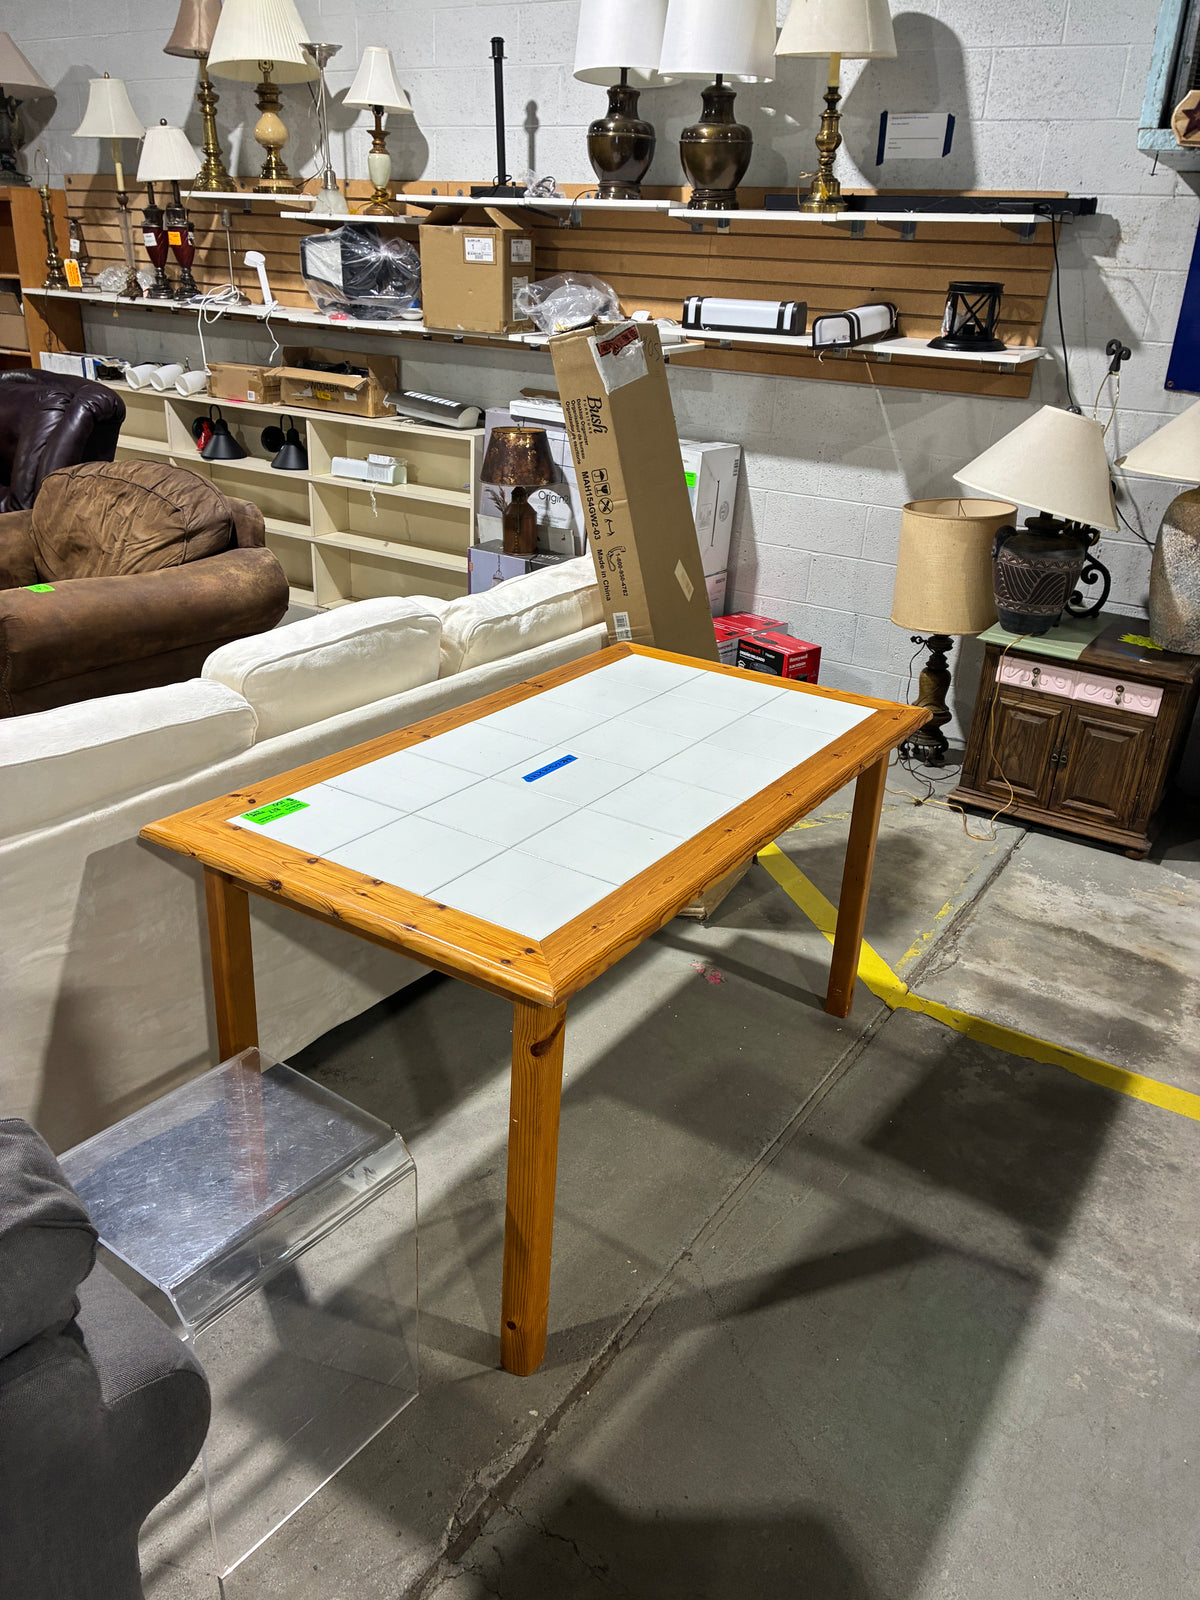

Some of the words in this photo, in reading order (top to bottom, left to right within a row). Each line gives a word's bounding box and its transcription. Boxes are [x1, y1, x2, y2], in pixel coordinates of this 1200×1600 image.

[576, 398, 584, 420] Desktop
[580, 420, 589, 446] Organizer
[587, 395, 608, 434] Bush
[581, 470, 601, 541] MAH154GW2-03
[597, 549, 605, 570] Made
[601, 570, 607, 579] in
[603, 579, 611, 602] China
